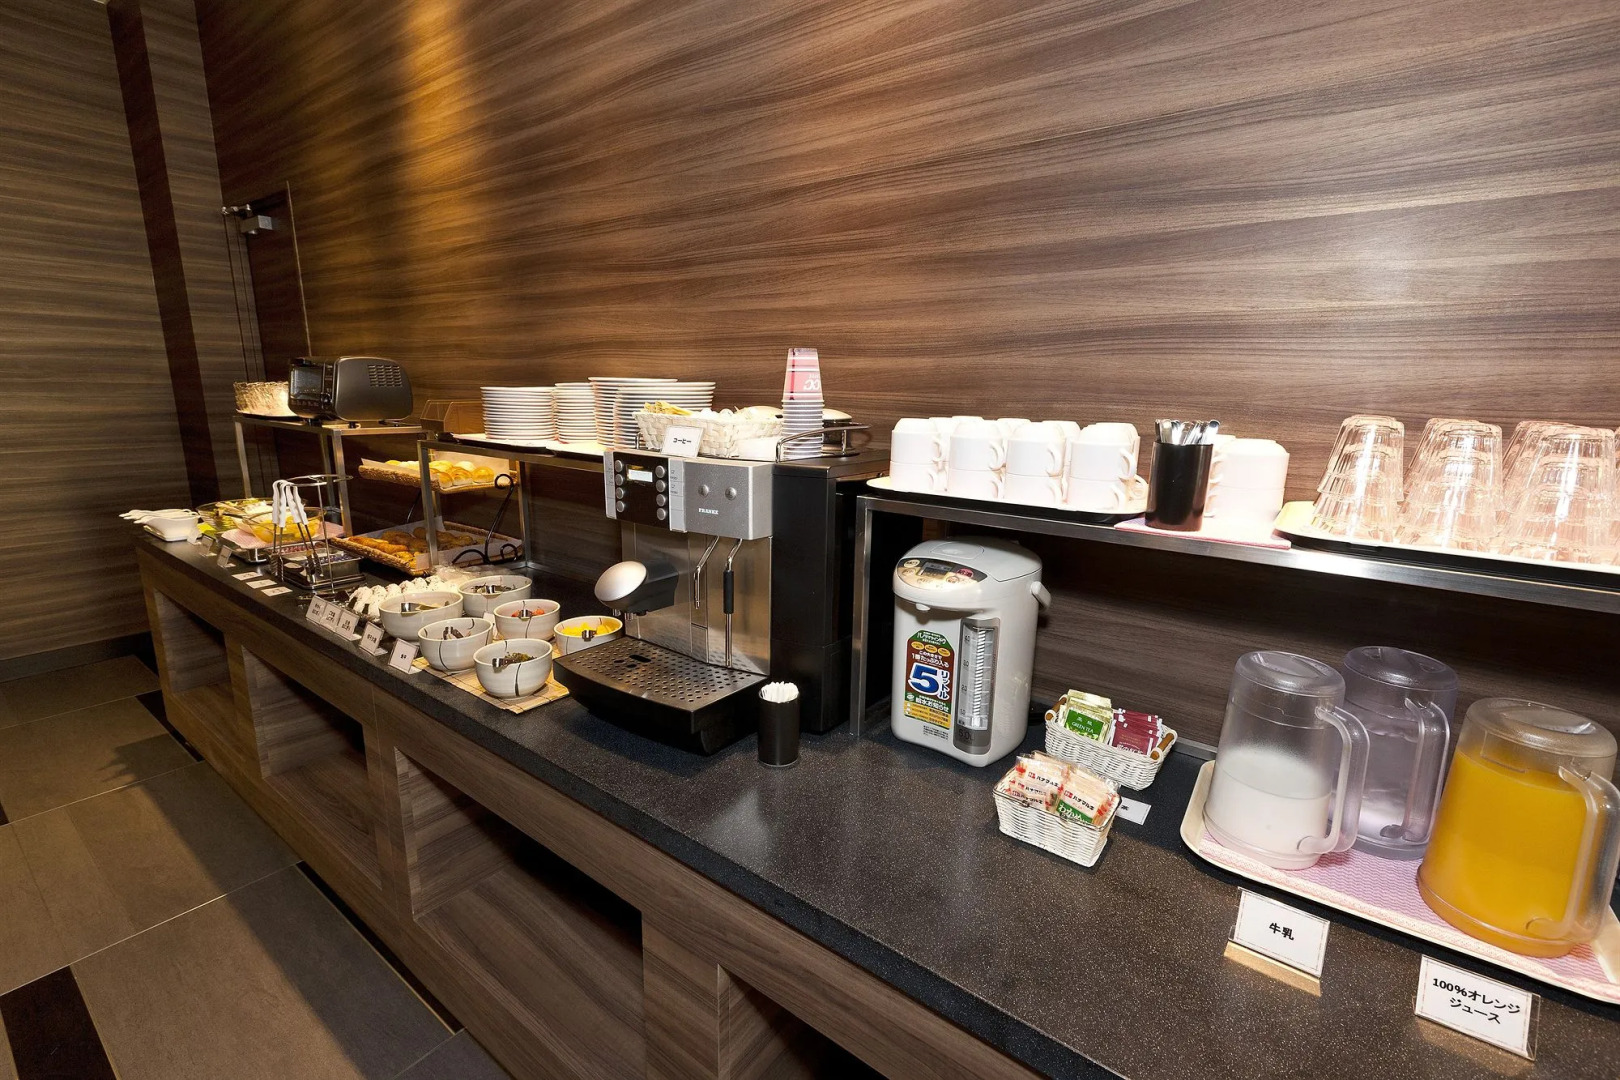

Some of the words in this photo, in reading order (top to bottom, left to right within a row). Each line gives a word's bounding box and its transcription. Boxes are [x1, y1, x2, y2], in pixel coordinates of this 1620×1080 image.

[698, 507, 719, 515] FRANKE
[1072, 795, 1095, 811] ハナマルキ
[1269, 922, 1295, 942] 牛乳
[1432, 978, 1521, 1014] 100%オレンジ
[1449, 996, 1501, 1025] ジュース
